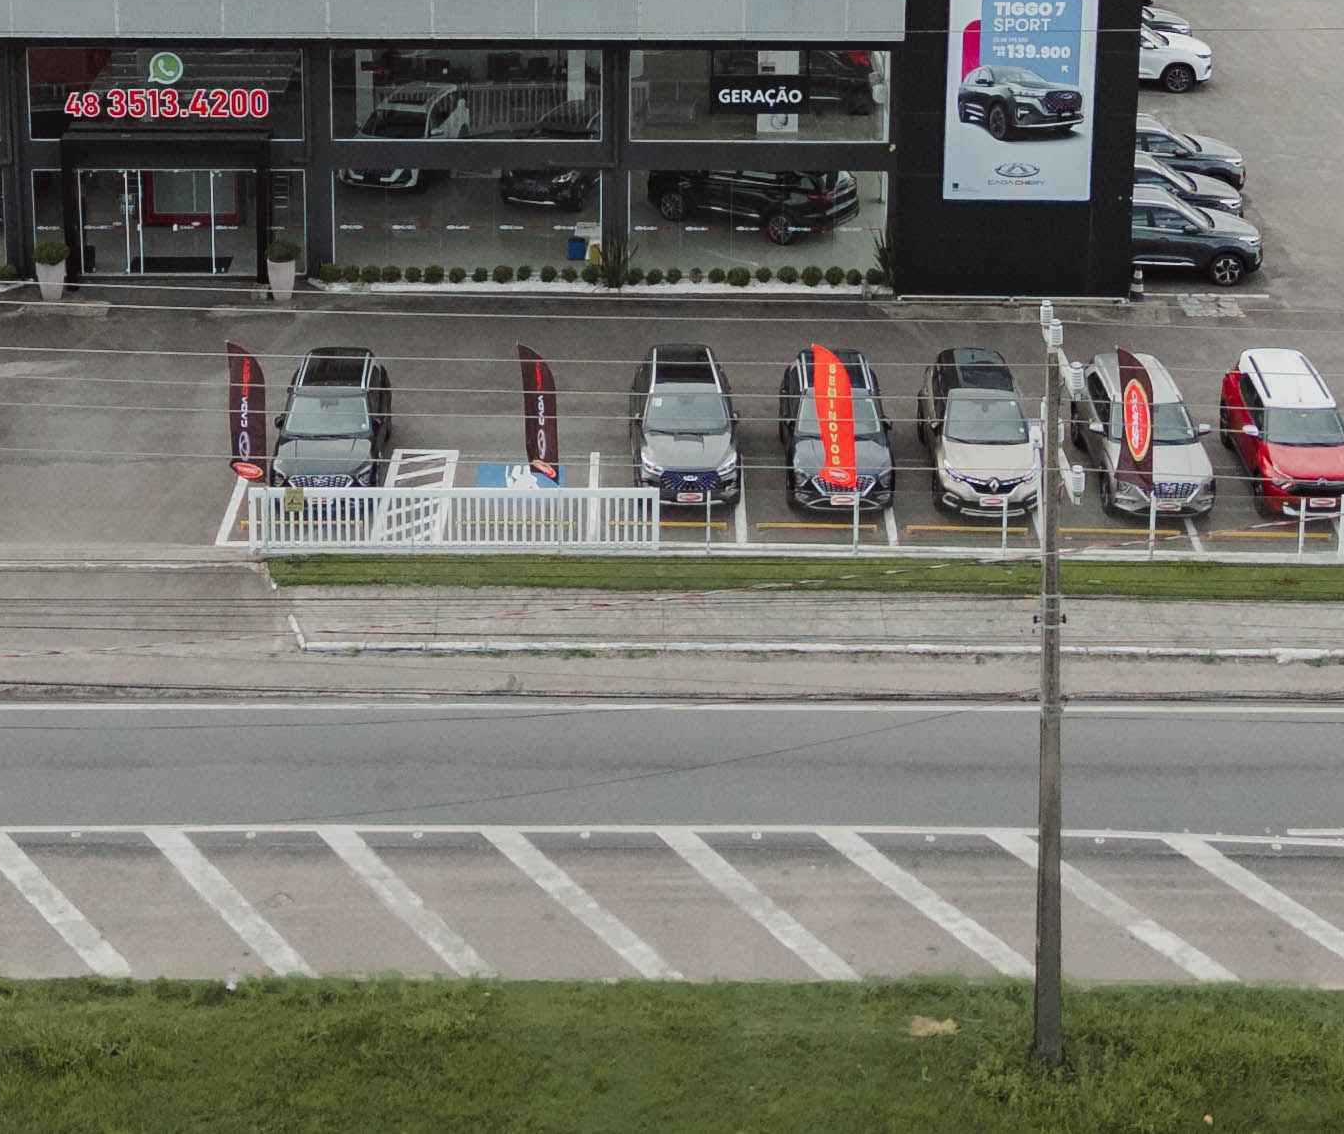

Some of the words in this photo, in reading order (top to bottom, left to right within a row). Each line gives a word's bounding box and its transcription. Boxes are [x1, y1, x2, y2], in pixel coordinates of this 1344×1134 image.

[994, 1, 1053, 16] TIGGO
[1055, 1, 1066, 16] 7
[994, 18, 1051, 31] SPORT
[1006, 44, 1071, 59] 139.900
[64, 91, 101, 117] 48
[107, 88, 269, 118] 3513.4200
[718, 86, 803, 107] GERAÇÃO
